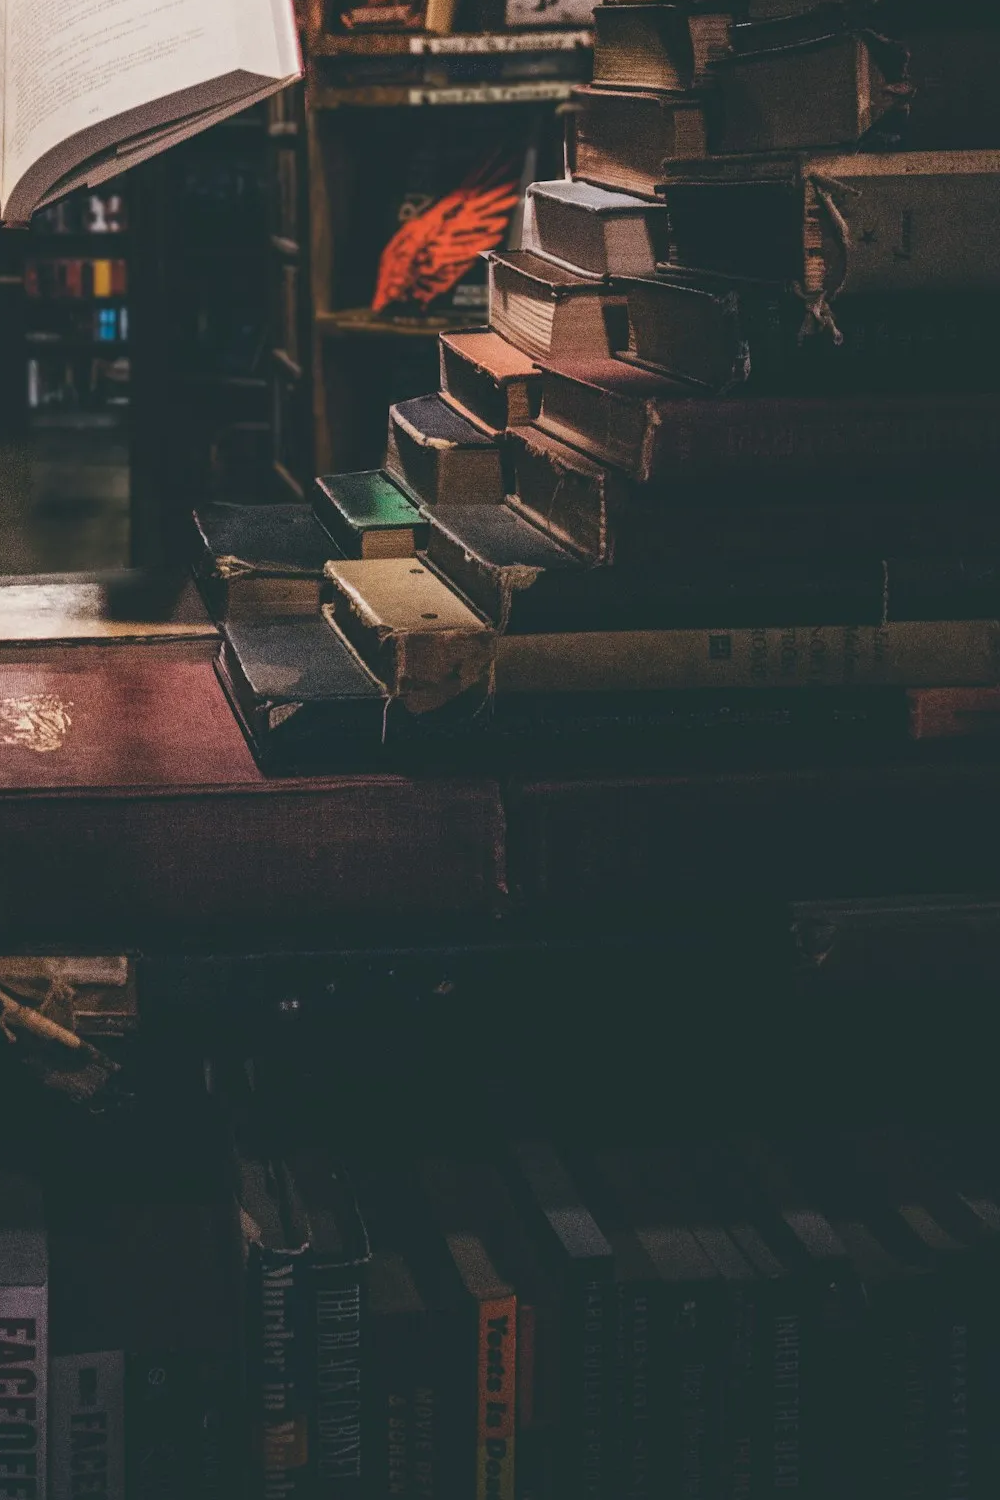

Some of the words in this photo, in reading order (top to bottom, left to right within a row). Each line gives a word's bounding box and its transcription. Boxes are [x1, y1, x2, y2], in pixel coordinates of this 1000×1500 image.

[262, 1263, 294, 1373] Murder
[317, 1284, 361, 1326] THE
[317, 1332, 361, 1394] BLACK
[486, 1314, 509, 1393] Yeats
[262, 1382, 294, 1411] in
[772, 1396, 800, 1433] THE
[317, 1399, 361, 1479] CABINET
